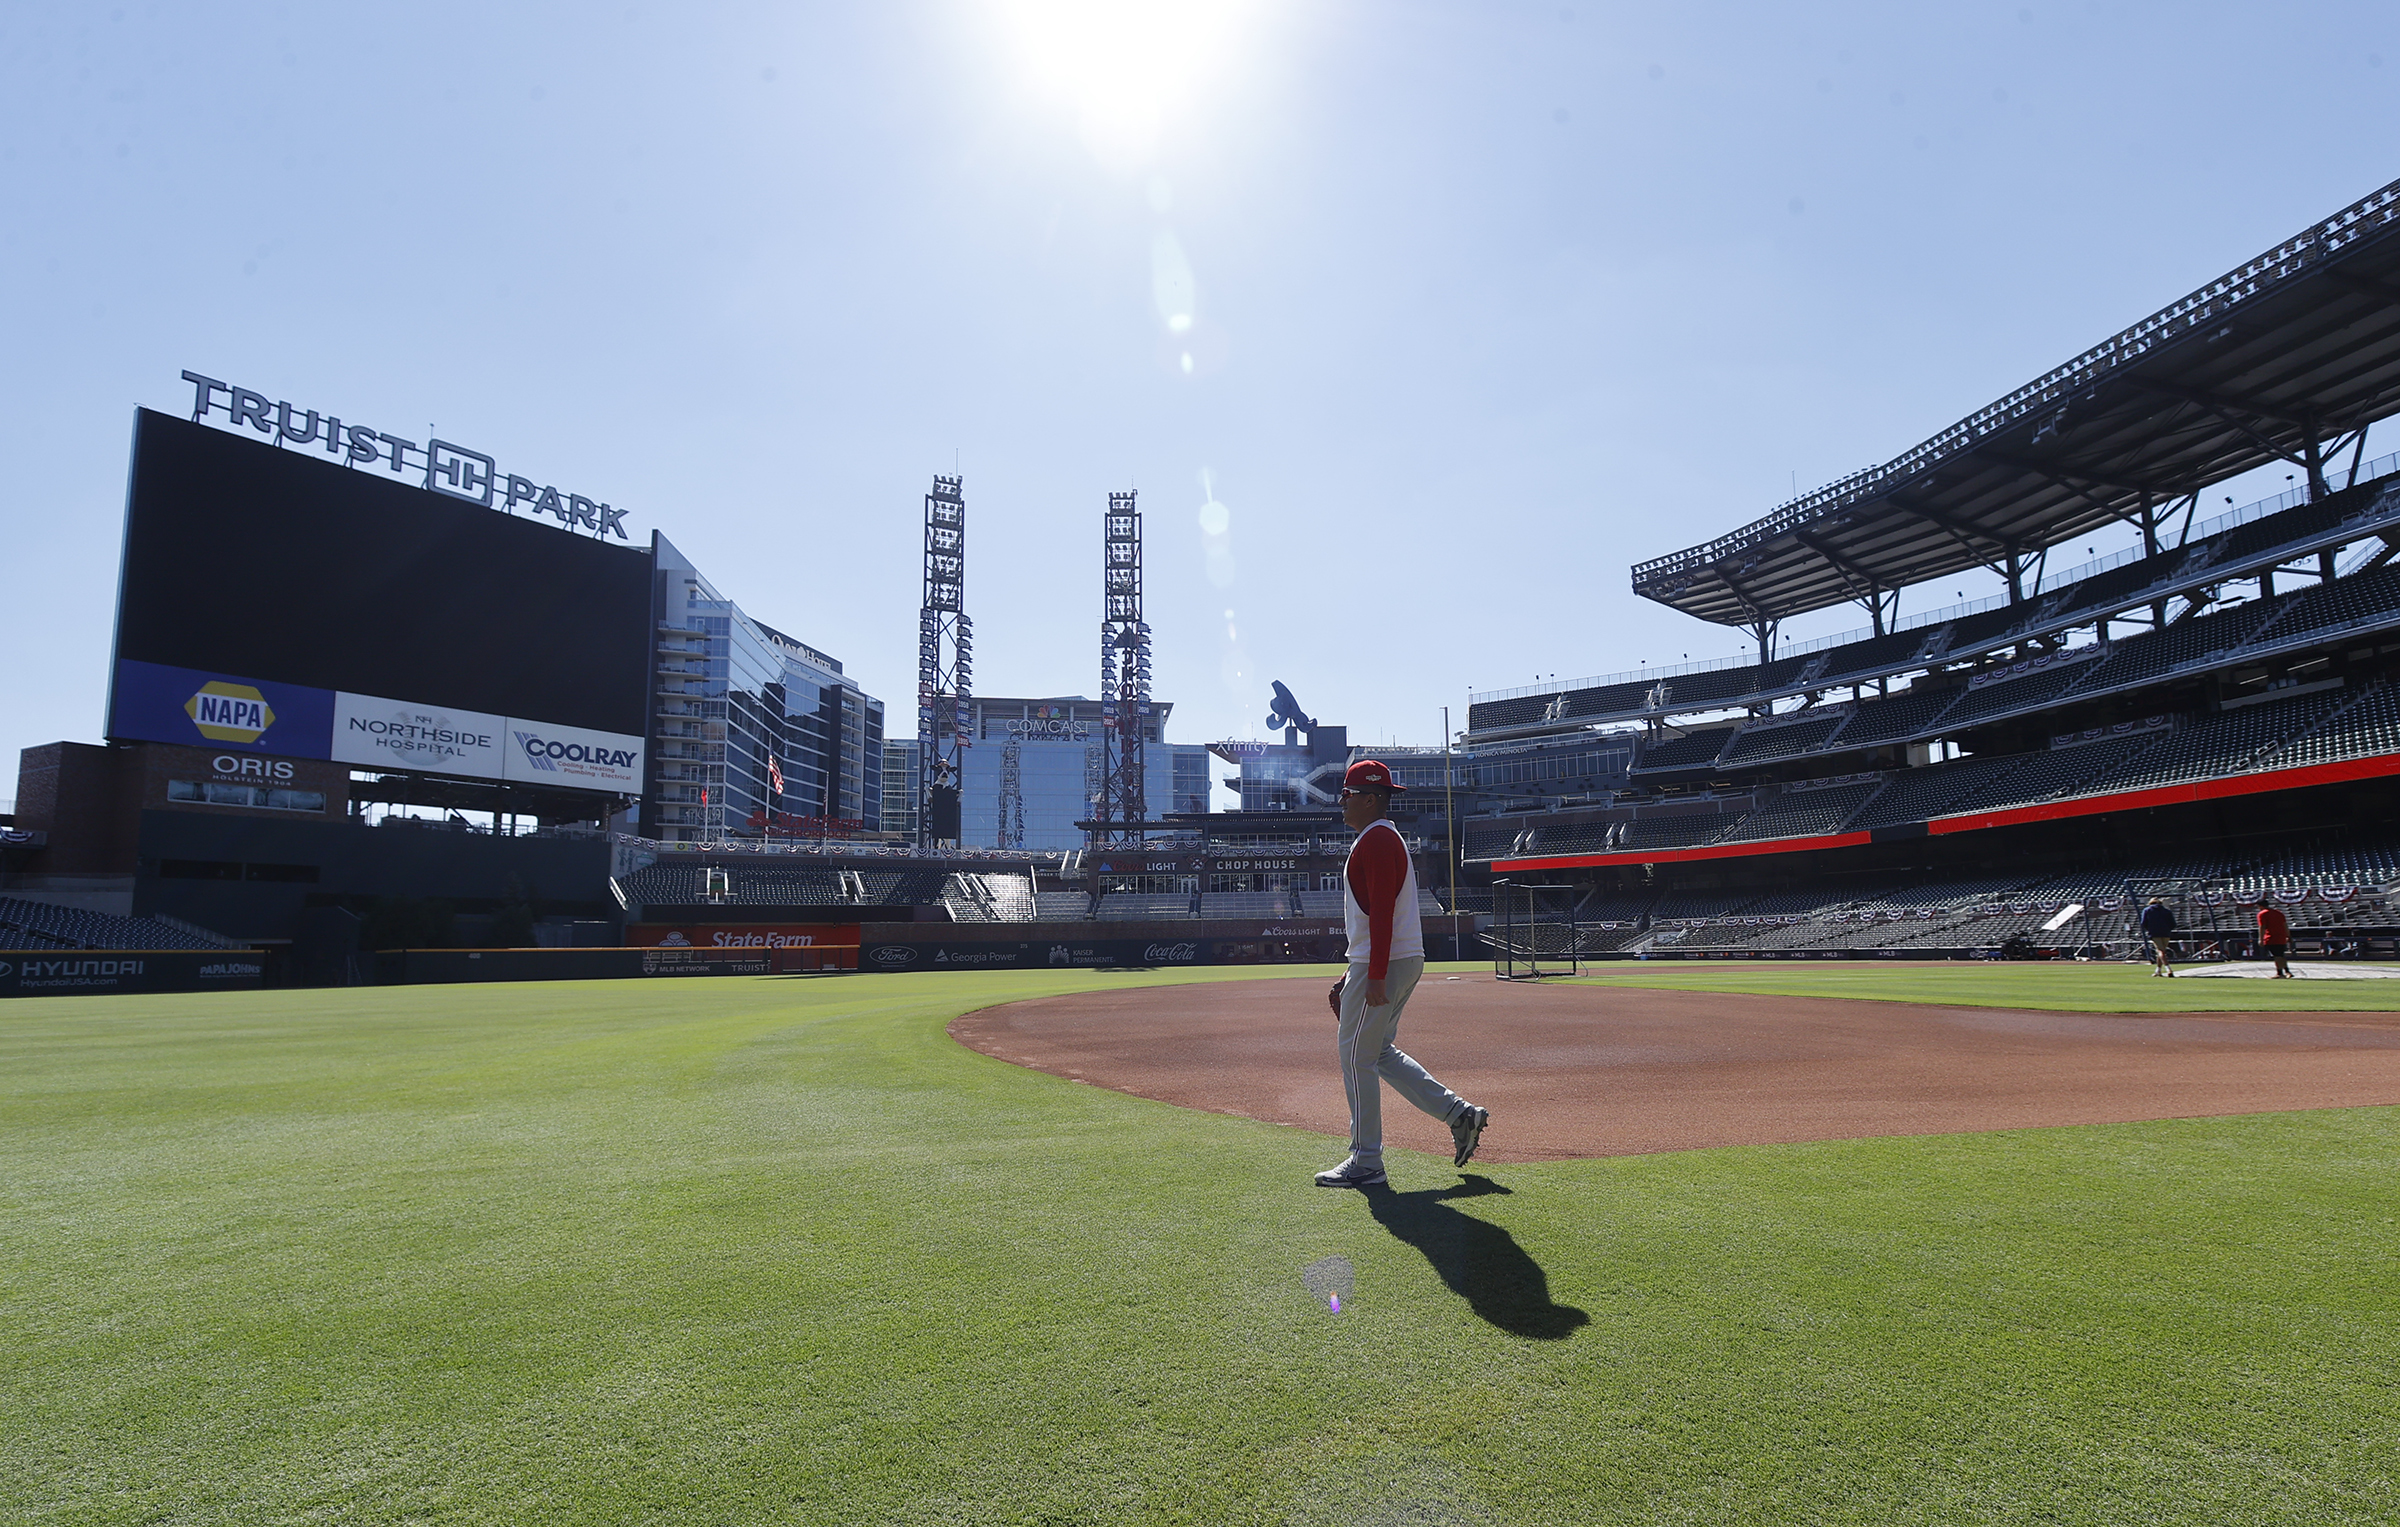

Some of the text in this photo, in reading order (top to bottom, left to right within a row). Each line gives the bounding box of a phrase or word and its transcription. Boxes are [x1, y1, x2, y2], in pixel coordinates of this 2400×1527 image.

[181, 369, 630, 541] TRUIST PARK
[201, 696, 262, 728] NAPA
[1006, 719, 1091, 734] COMCAST
[1104, 718, 1114, 726] 2021
[350, 717, 491, 748] NORTHSIDE
[376, 737, 466, 757] HOSPITAL
[1216, 736, 1269, 755] xfinity
[525, 738, 637, 768] COOLRAY
[1476, 750, 1499, 758] KONICA
[212, 755, 294, 779] ORIS
[557, 760, 615, 773] Cooling Heating
[564, 768, 631, 780] Plumbing Electrical
[1112, 860, 1177, 872] Coors LIGHT
[1216, 859, 1296, 870] CHOP HOUSE
[1272, 926, 1297, 936] Coors
[878, 948, 909, 961] Ford
[951, 952, 1017, 963] Georgia Power
[1144, 943, 1197, 961] Coca-Cola
[21, 960, 143, 976] HYUNDAI
[732, 964, 765, 972] TRUIST
[20, 977, 117, 988] HyundaiUSA.com
